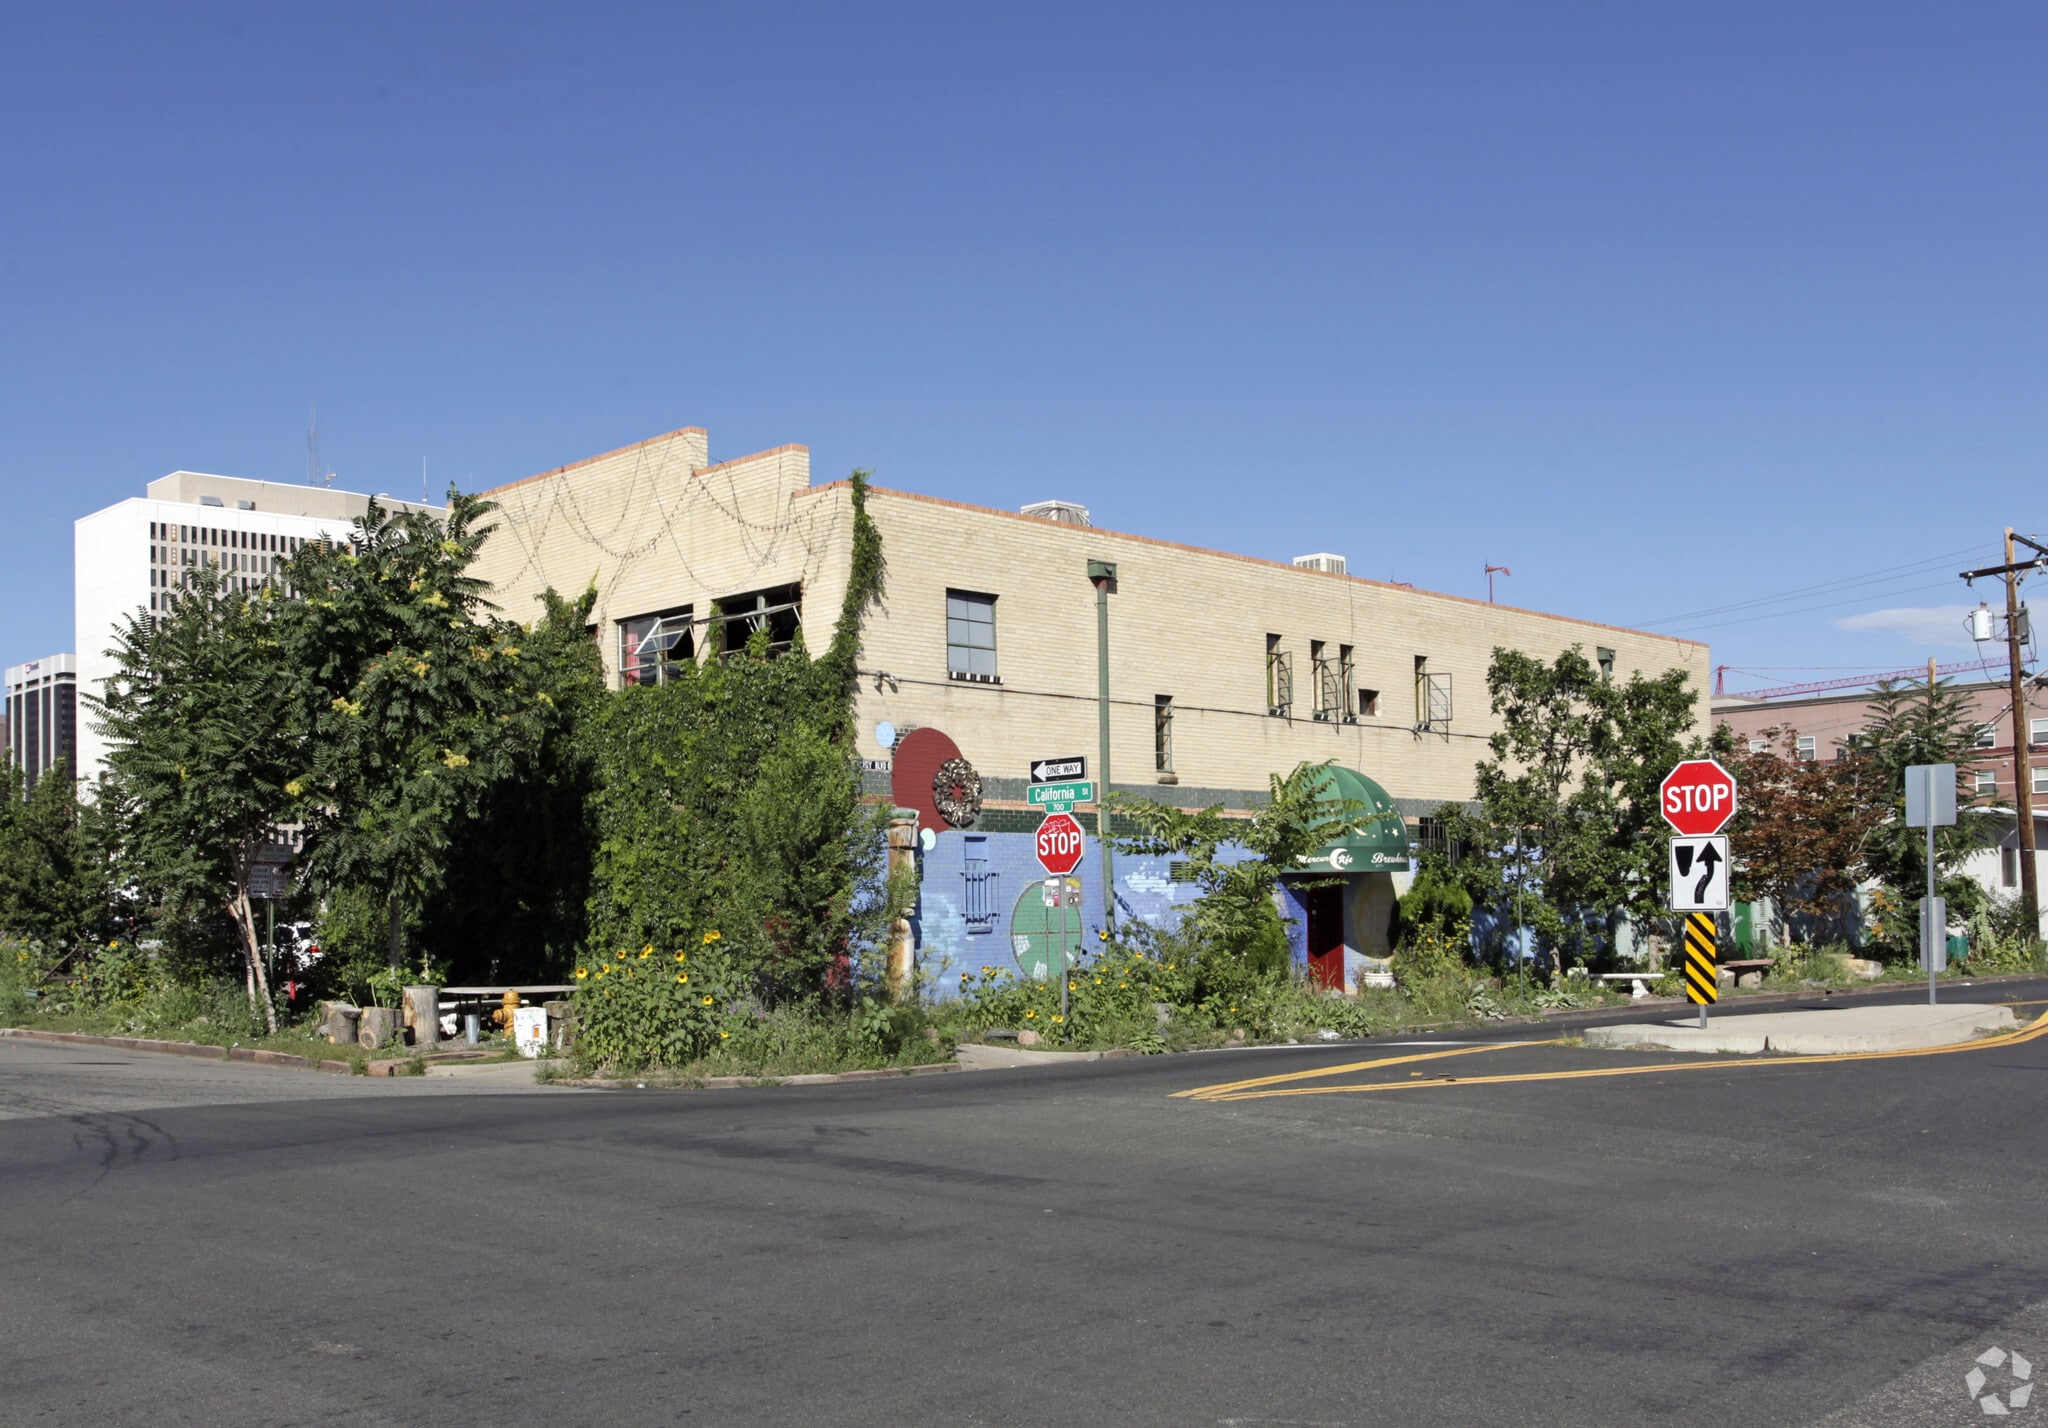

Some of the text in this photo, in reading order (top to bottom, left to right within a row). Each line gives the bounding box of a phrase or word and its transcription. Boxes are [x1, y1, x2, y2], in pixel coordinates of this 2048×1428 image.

[1046, 763, 1079, 776] ONE WAY
[1035, 786, 1075, 801] California
[1666, 784, 1729, 813] STOP
[1053, 803, 1064, 811] 700
[1039, 832, 1080, 856] STOP
